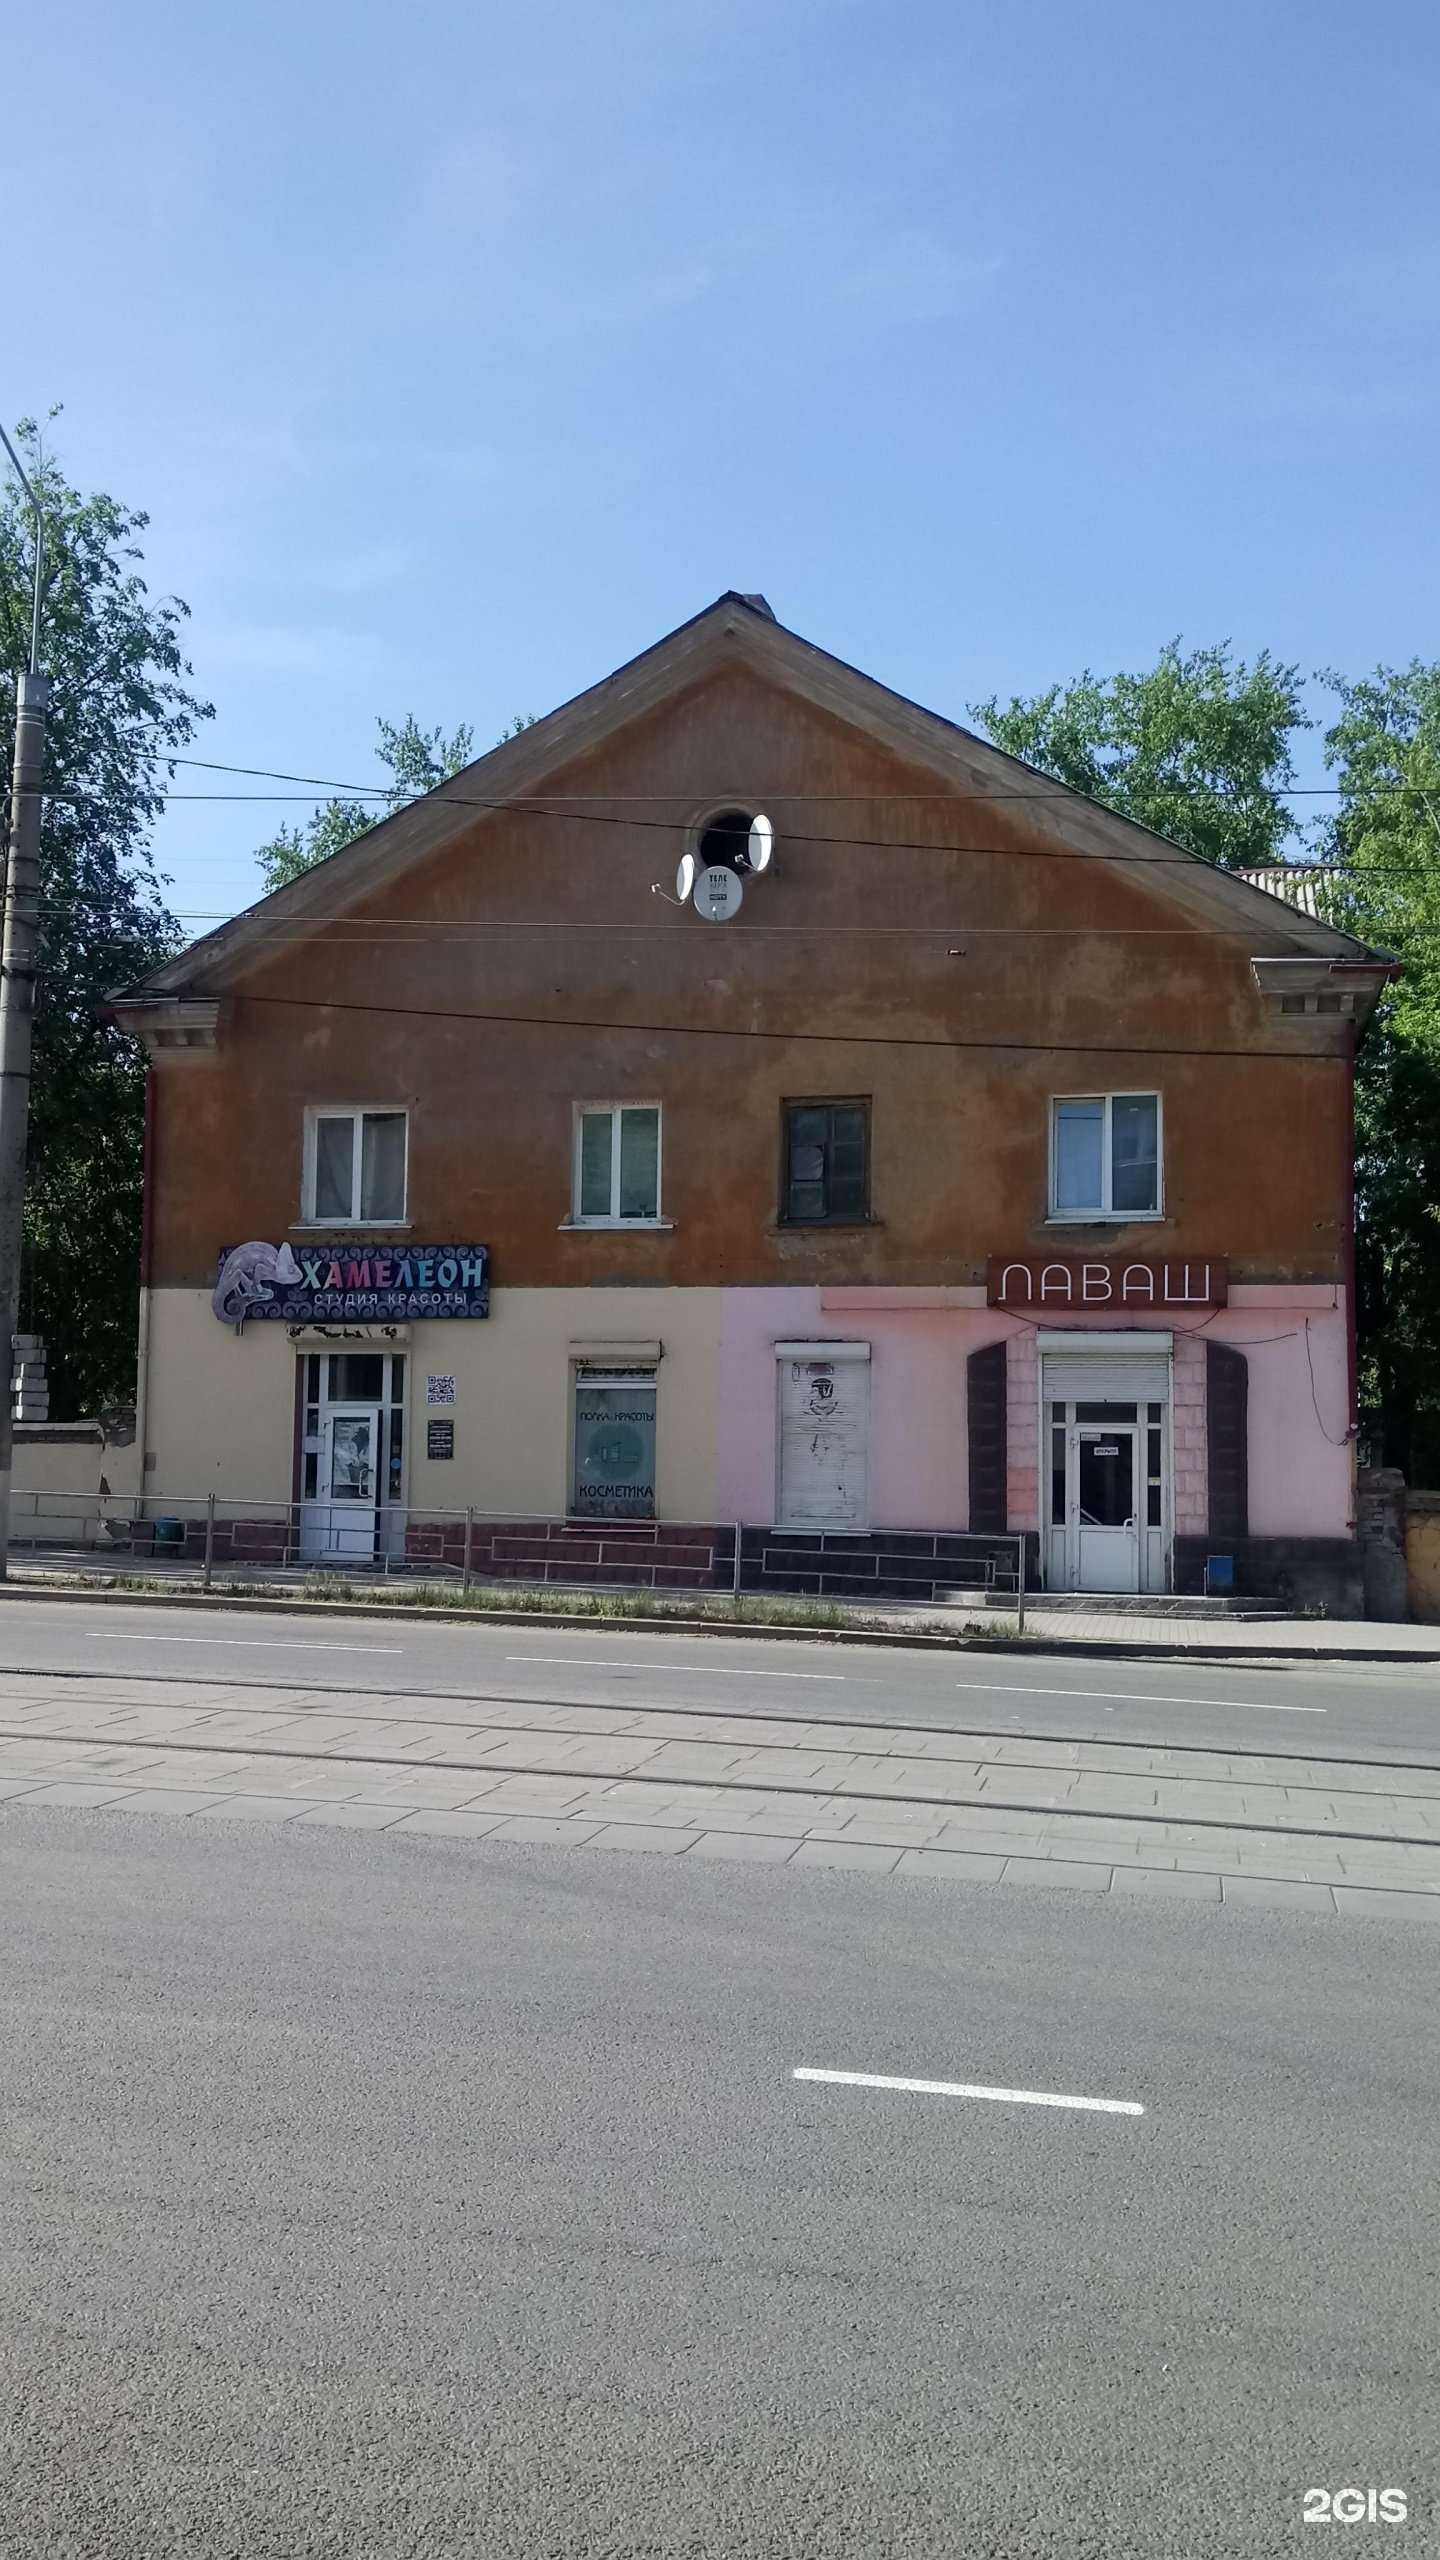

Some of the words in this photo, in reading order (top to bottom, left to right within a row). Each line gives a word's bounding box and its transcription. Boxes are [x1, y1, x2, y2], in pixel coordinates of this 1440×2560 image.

[300, 1258, 482, 1290] ХАМЕЛЕОН
[998, 1264, 1209, 1301] ЛАВАШ
[314, 1293, 378, 1306] СТУДИЯ
[388, 1292, 467, 1305] КРАСОТЫ
[579, 1484, 654, 1498] КОСМЕТИКА
